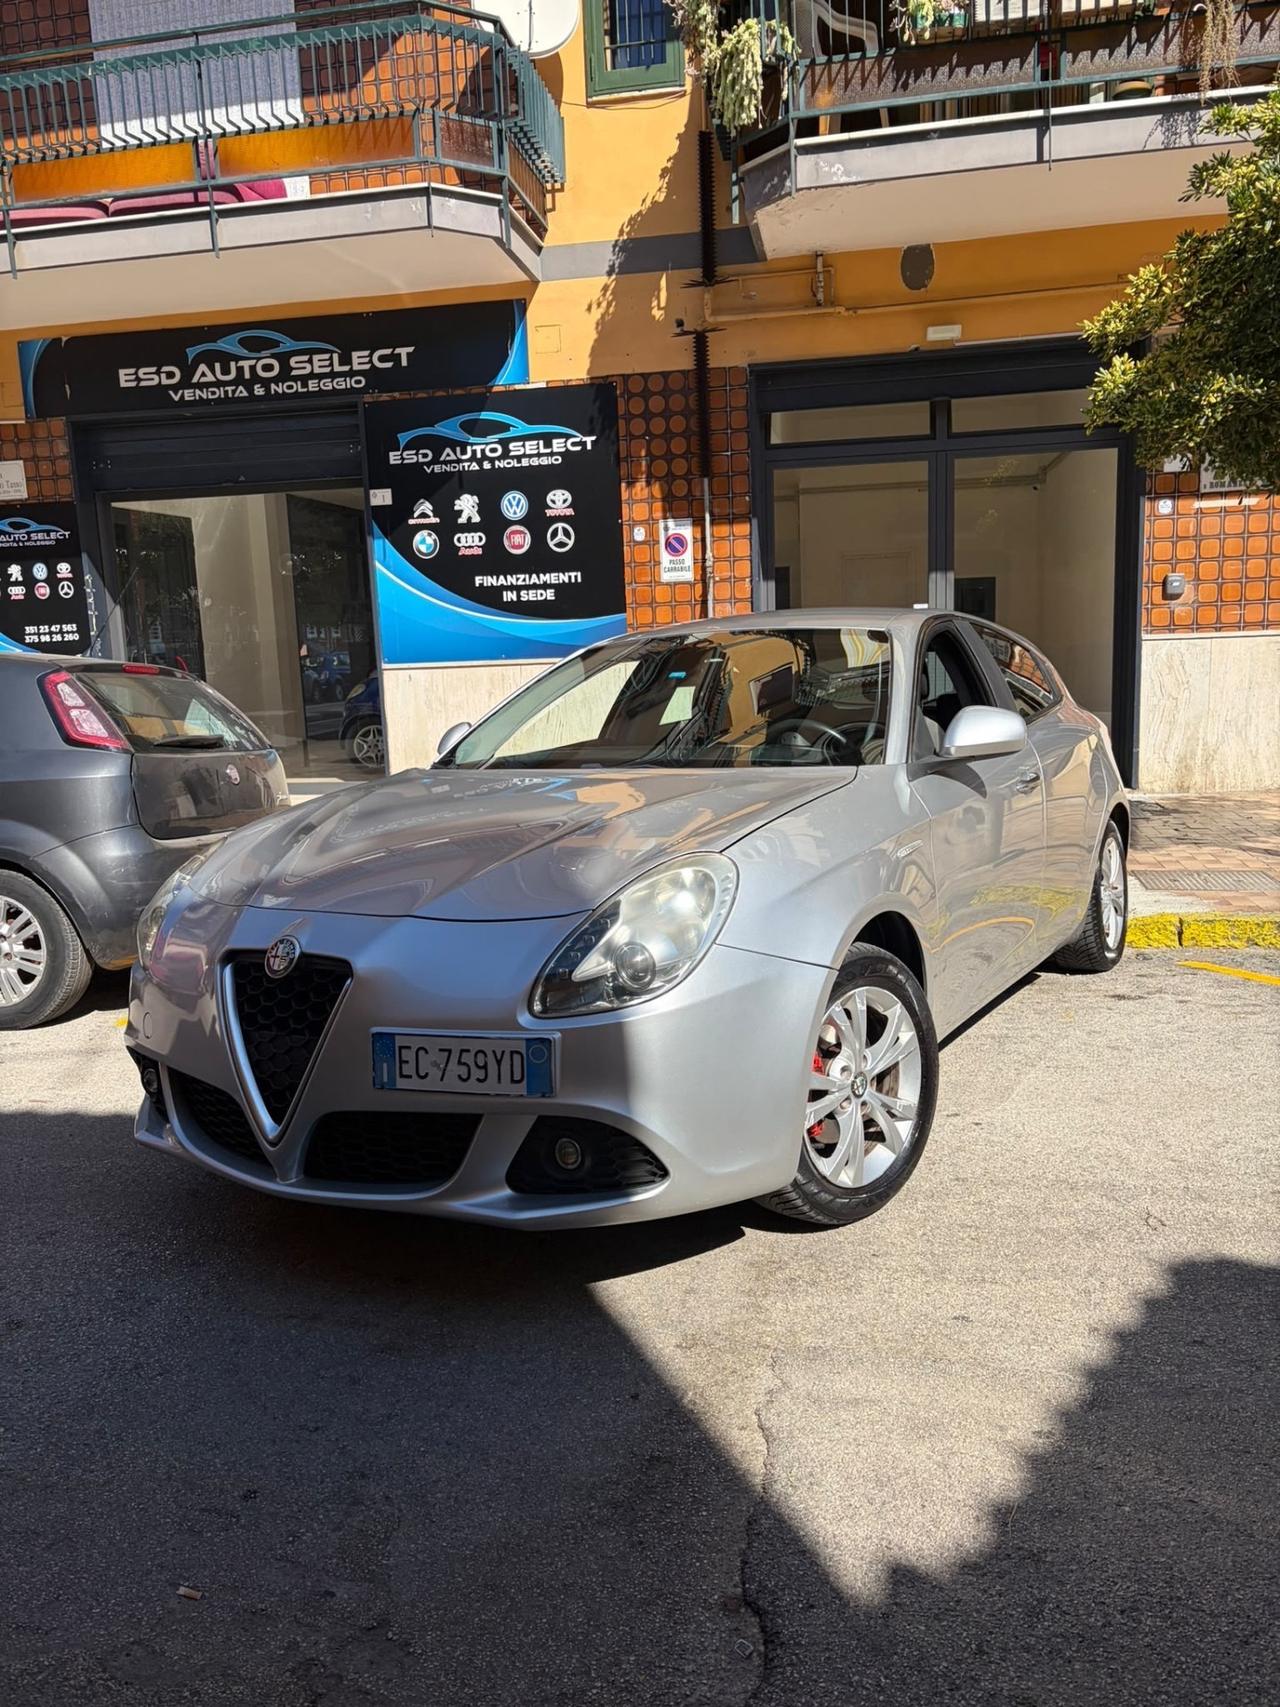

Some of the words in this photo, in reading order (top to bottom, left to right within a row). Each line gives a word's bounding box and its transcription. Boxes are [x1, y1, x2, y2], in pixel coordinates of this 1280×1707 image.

[118, 367, 181, 388] ESD
[191, 357, 280, 384] AUTO
[290, 346, 416, 376] SELECT
[168, 385, 249, 402] VENDITA
[254, 384, 265, 396] &
[270, 375, 366, 395] NOLEGGIO
[388, 450, 433, 465] ESD
[439, 443, 503, 461] AUTO
[508, 435, 598, 456] SELECT
[423, 462, 480, 474] VENDITA
[483, 460, 492, 469] &
[495, 455, 562, 469] NOLEGGIO
[0, 532, 28, 542] AUTO
[30, 531, 71, 541] SELECT
[474, 571, 582, 587] FINANZIAMENTI
[502, 590, 517, 602] IN
[520, 589, 556, 601] SEDE
[397, 1045, 429, 1080] EC
[438, 1048, 525, 1085] 759YD
